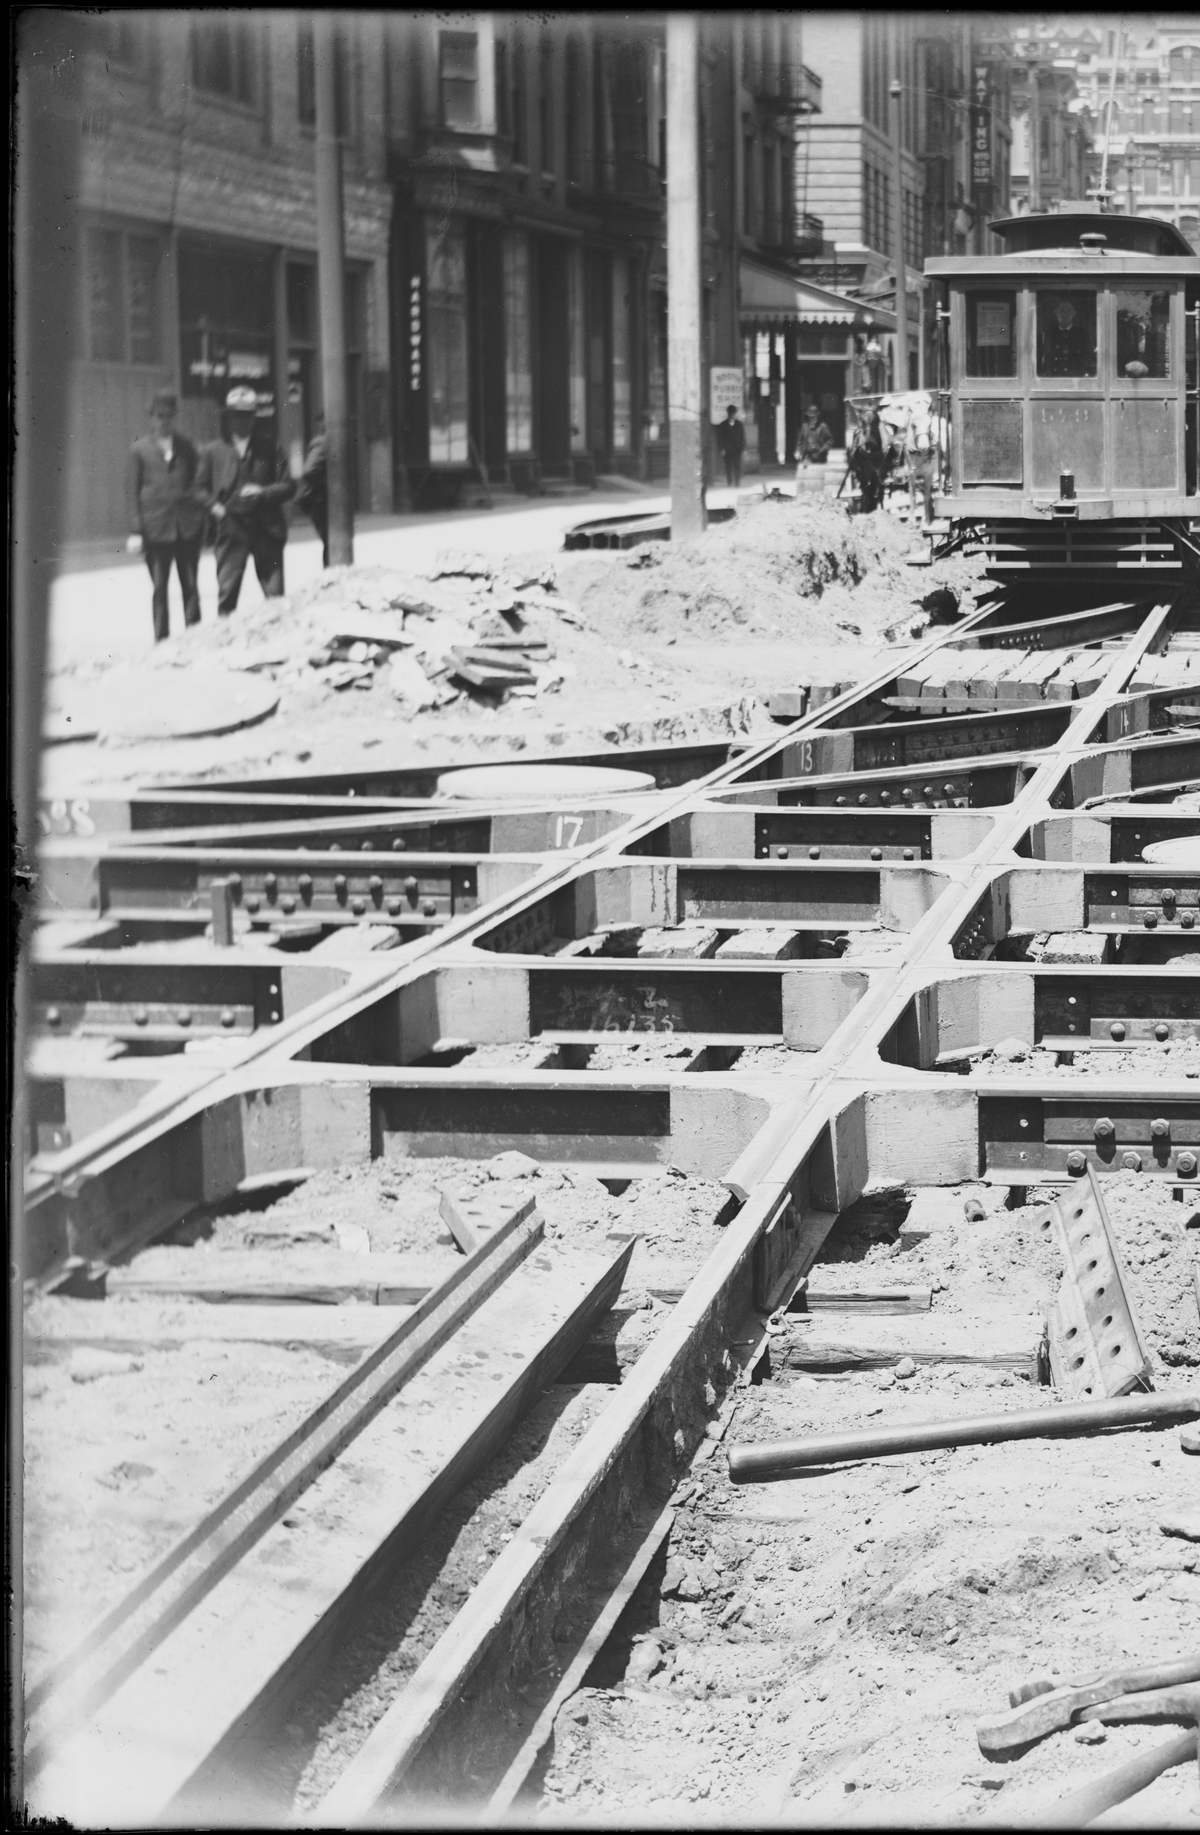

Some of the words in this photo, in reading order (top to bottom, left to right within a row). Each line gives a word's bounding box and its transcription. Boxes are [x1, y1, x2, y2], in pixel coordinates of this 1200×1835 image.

[975, 67, 989, 150] WATING
[409, 276, 421, 391] HARDWARE
[801, 742, 813, 773] 13
[556, 815, 584, 849] 17
